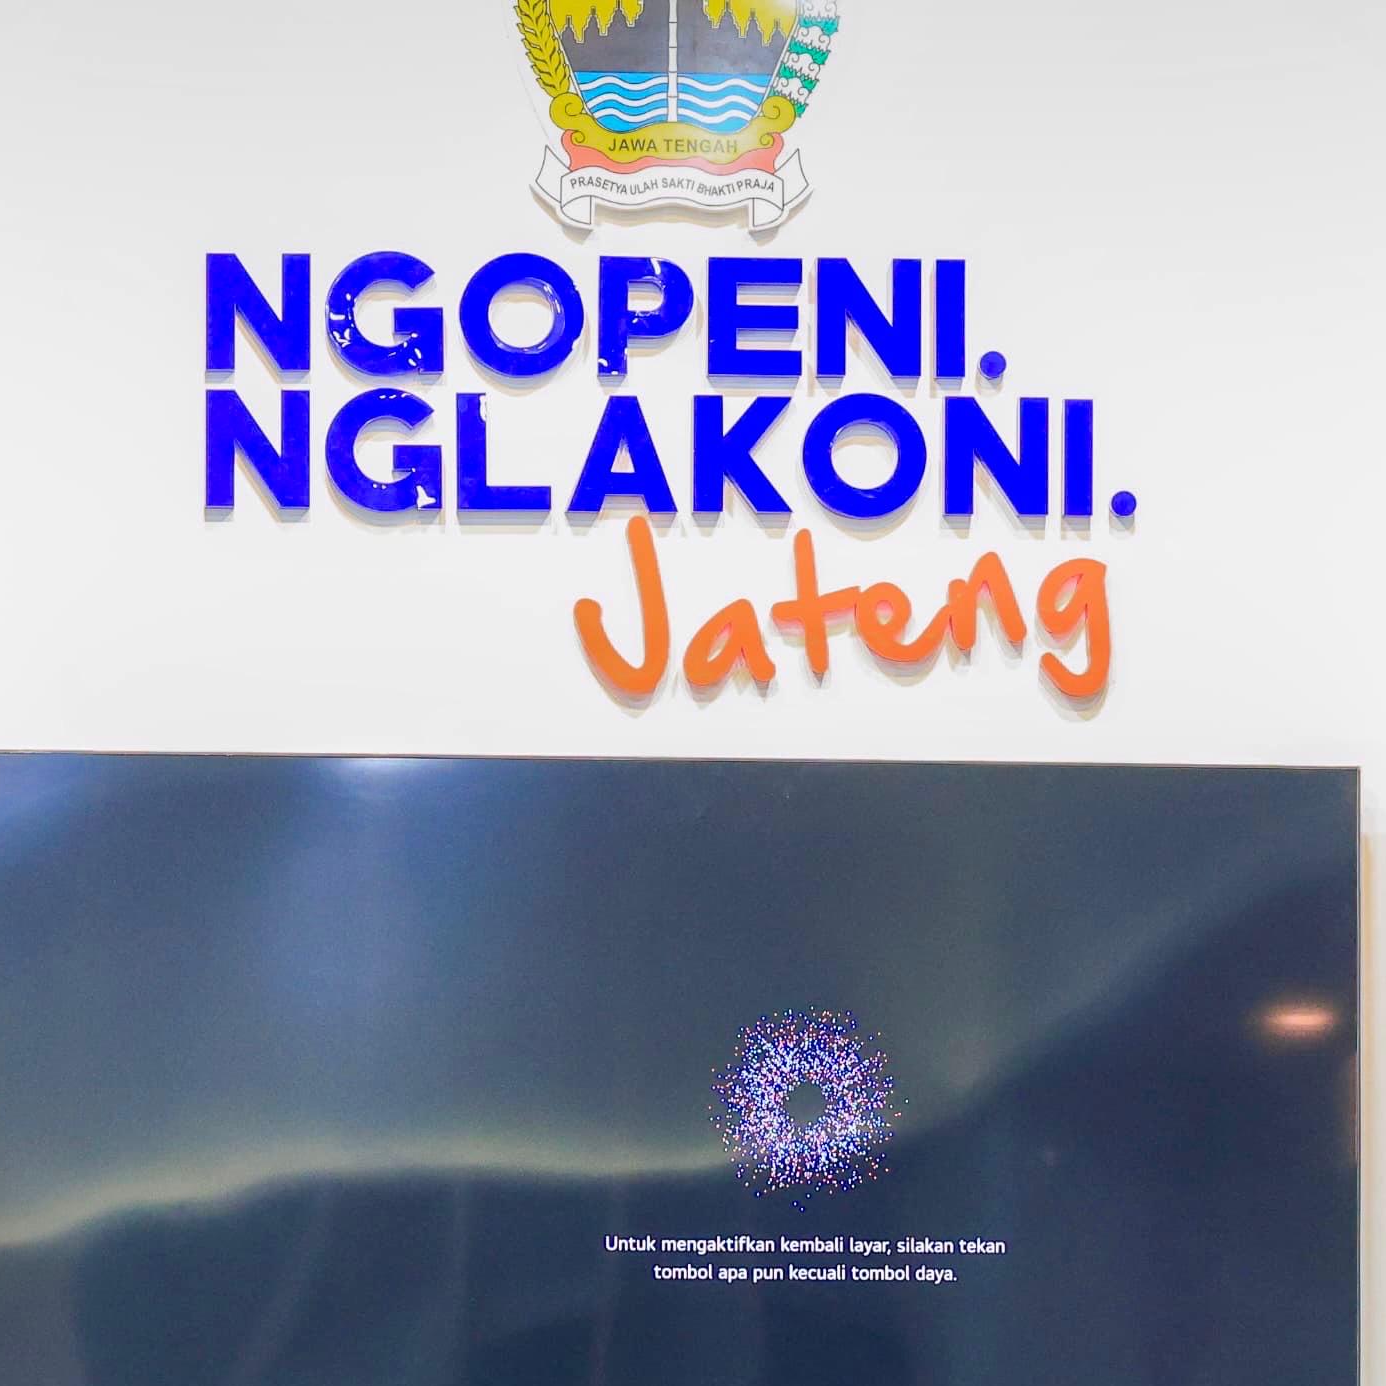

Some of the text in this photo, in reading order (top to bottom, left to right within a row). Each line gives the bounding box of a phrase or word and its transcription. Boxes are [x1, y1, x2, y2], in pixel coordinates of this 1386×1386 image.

[608, 138, 737, 153] JAWA TENGAH
[570, 176, 774, 196] PRASETYA ULAH SAKTI BHAKTI PRAJA
[205, 250, 1007, 380] NGOPENI.
[204, 387, 1138, 519] NGLAKONI.
[572, 515, 1111, 699] Jateng
[605, 1235, 1006, 1256] Untuk mengaktifkan kembali layar, silakan tekan
[653, 1263, 958, 1284] tombol apa pun kecuali tombol daya.
